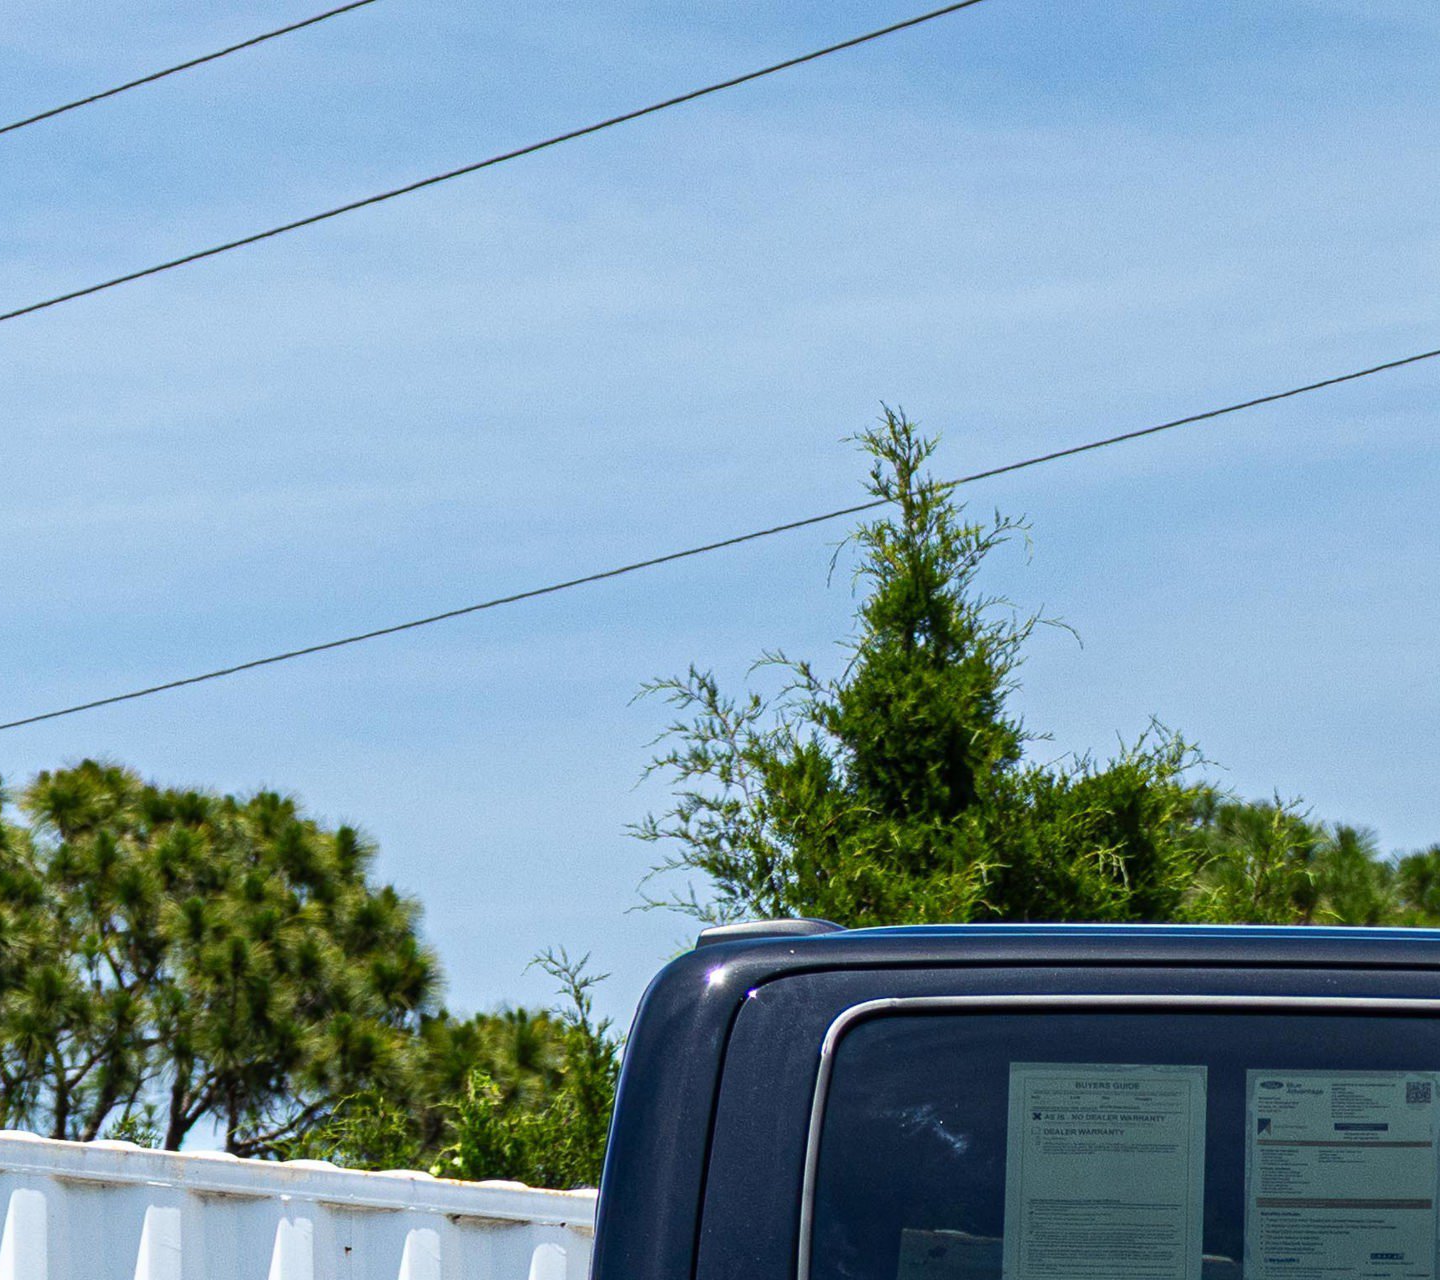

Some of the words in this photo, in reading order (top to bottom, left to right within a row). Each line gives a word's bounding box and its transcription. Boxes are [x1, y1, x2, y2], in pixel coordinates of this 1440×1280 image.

[1075, 1082, 1110, 1090] BUYERS
[1112, 1082, 1140, 1090] GUIDE
[1085, 1114, 1119, 1122] DEALER
[1120, 1114, 1166, 1122] WARRANTY
[1044, 1128, 1076, 1136] DEALER
[1078, 1128, 1125, 1136] WARRANTY
